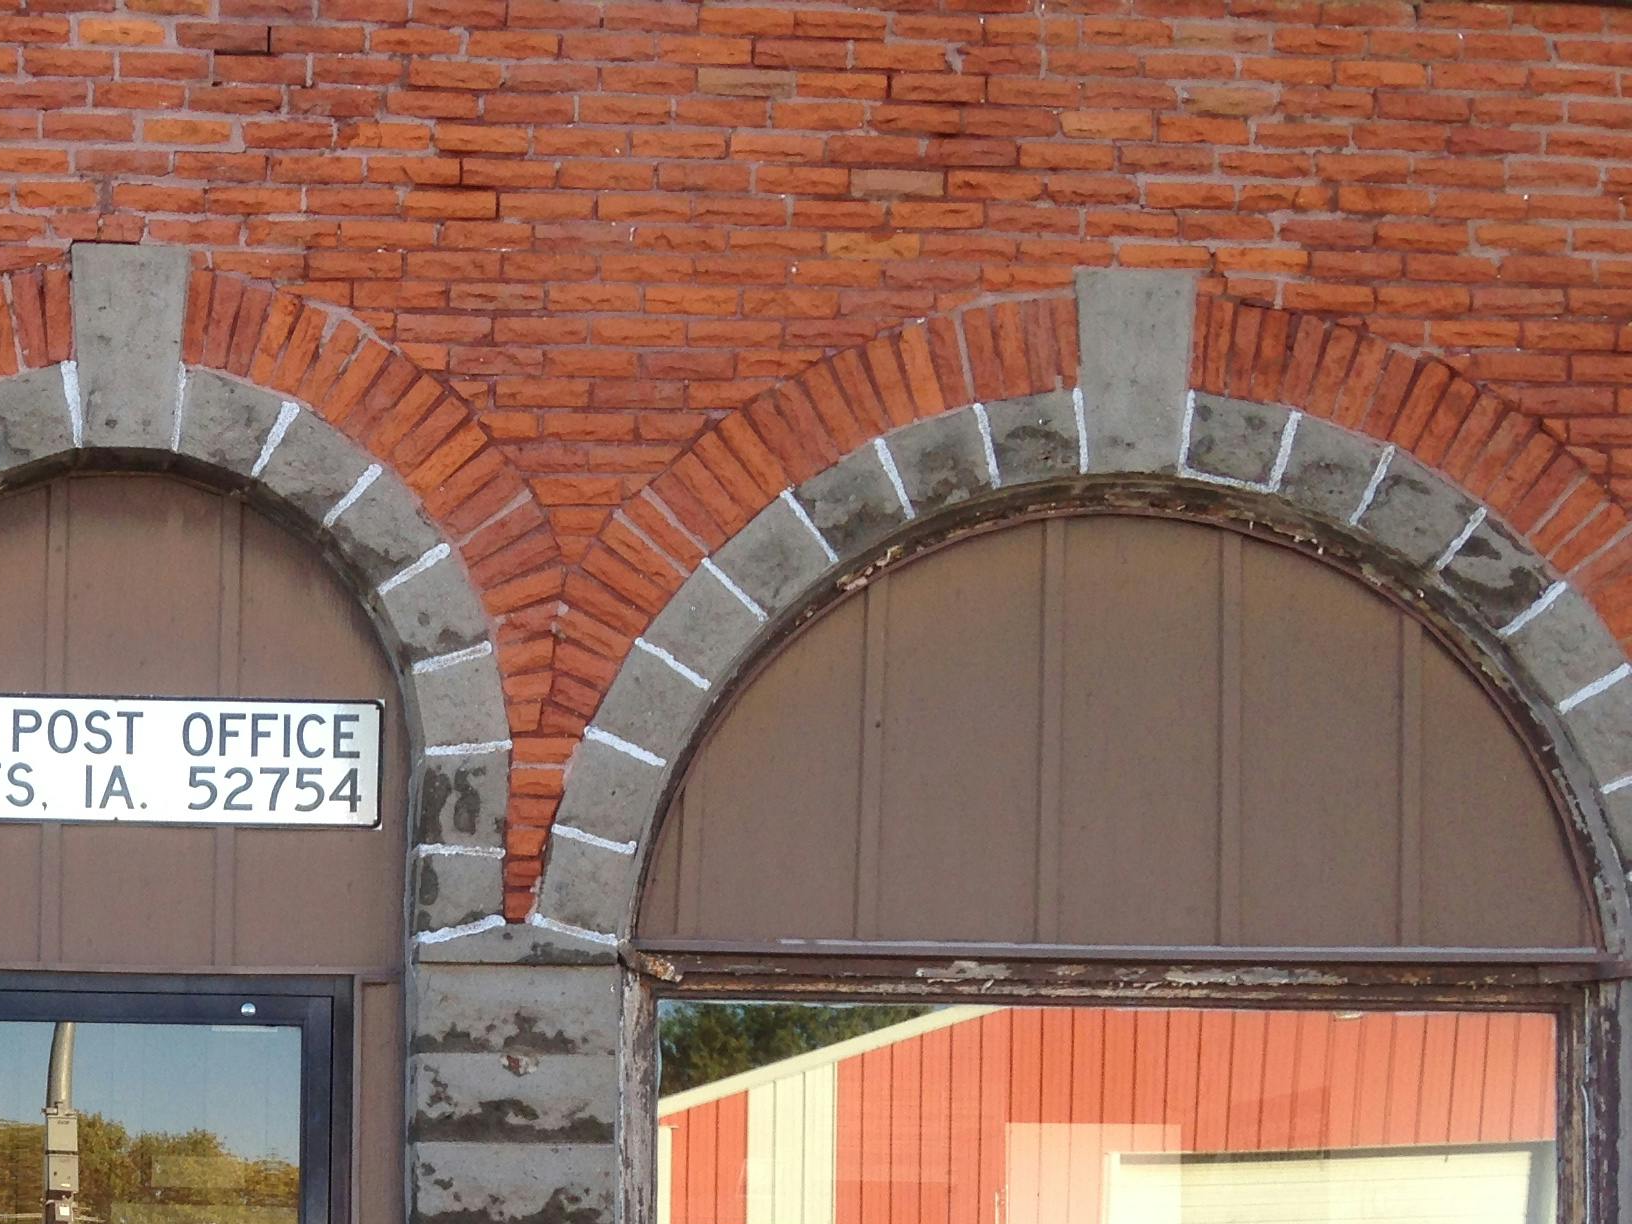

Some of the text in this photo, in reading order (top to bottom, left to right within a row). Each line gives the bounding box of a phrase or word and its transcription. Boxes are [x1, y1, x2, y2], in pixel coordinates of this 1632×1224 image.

[11, 709, 144, 756] POST
[182, 712, 361, 759] OFFICE
[85, 764, 148, 811] IA.
[187, 766, 362, 814] 52754
